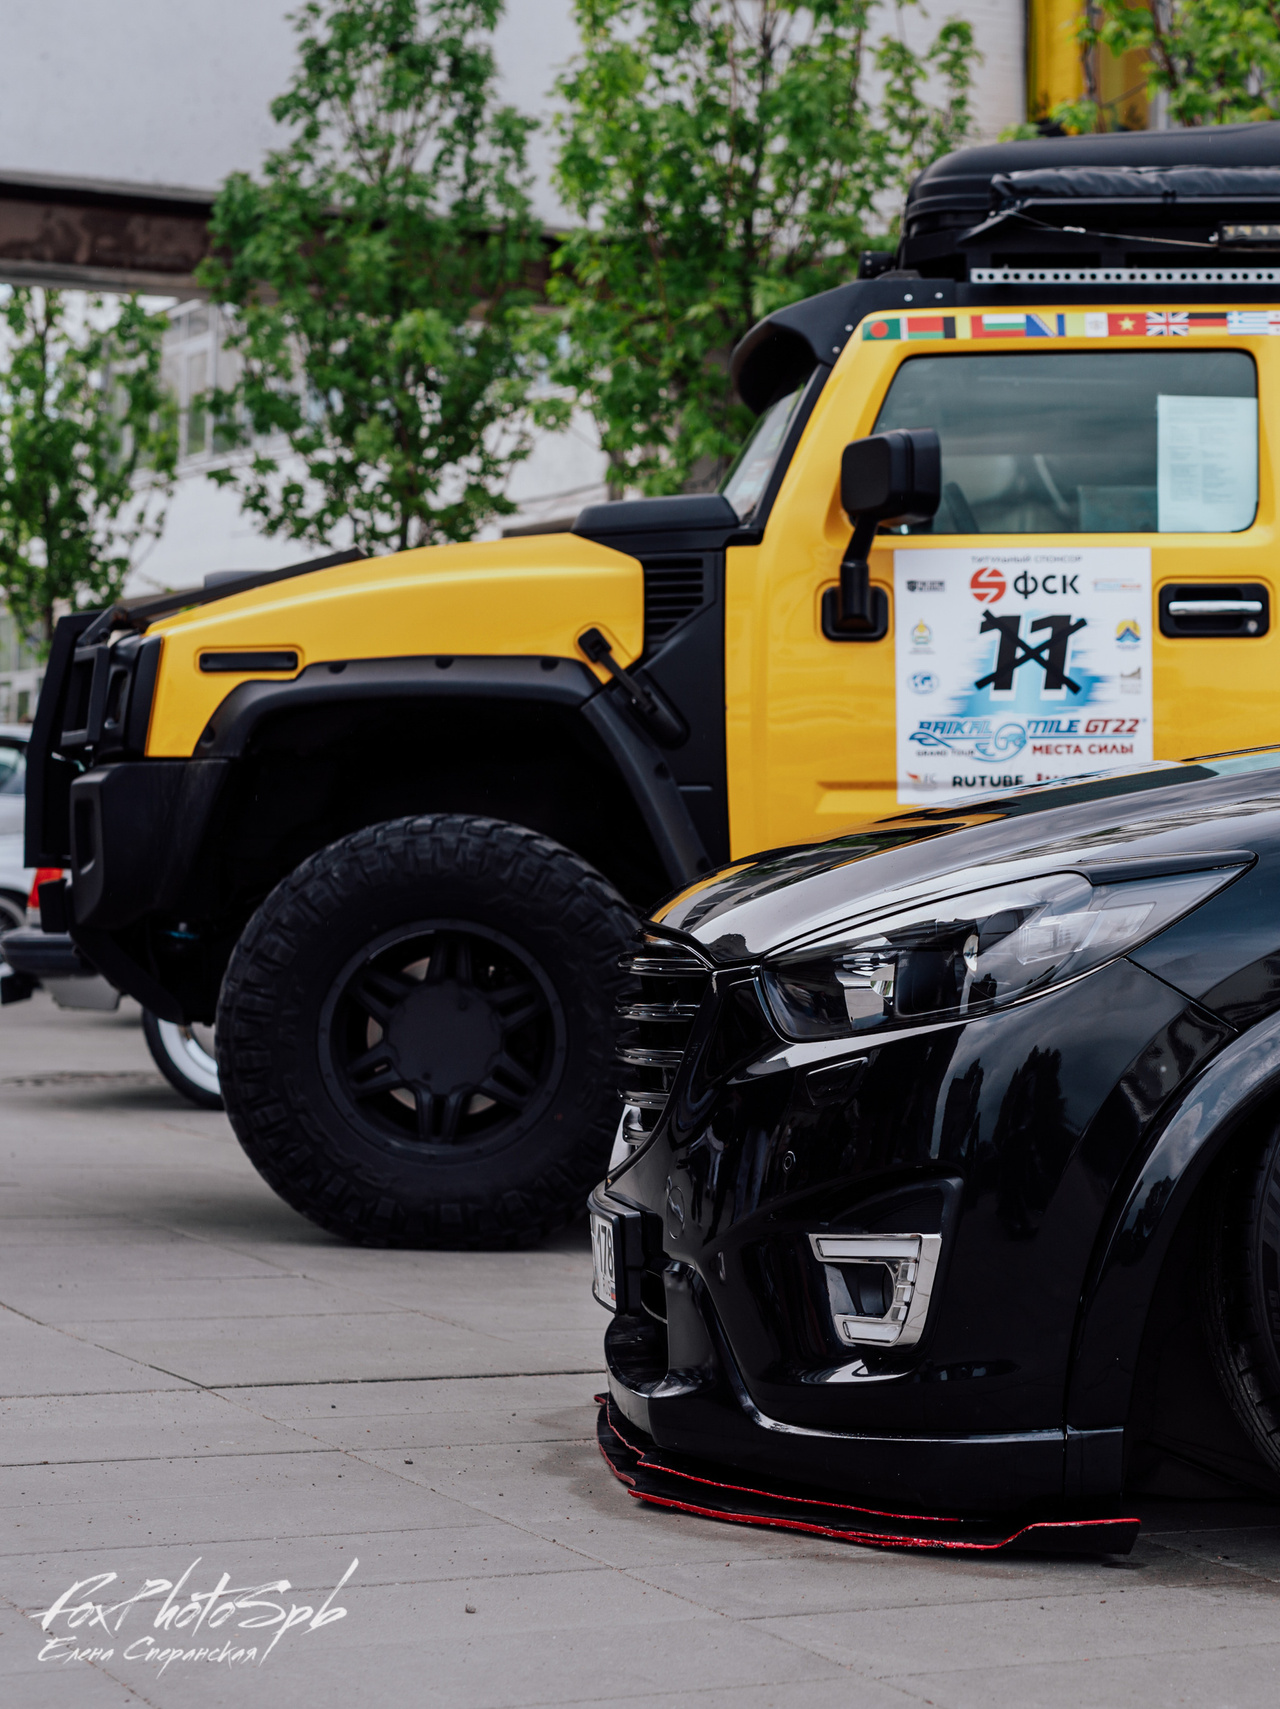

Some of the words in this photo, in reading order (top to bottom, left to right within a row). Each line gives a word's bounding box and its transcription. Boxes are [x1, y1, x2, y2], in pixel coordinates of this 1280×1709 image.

[1013, 570, 1079, 600] ФСК
[918, 720, 993, 735] BAIKAL
[1027, 719, 1081, 734] MILE
[1084, 718, 1139, 733] GT22
[1032, 743, 1082, 755] МЕСТА
[1088, 743, 1134, 755] СИЛЫ
